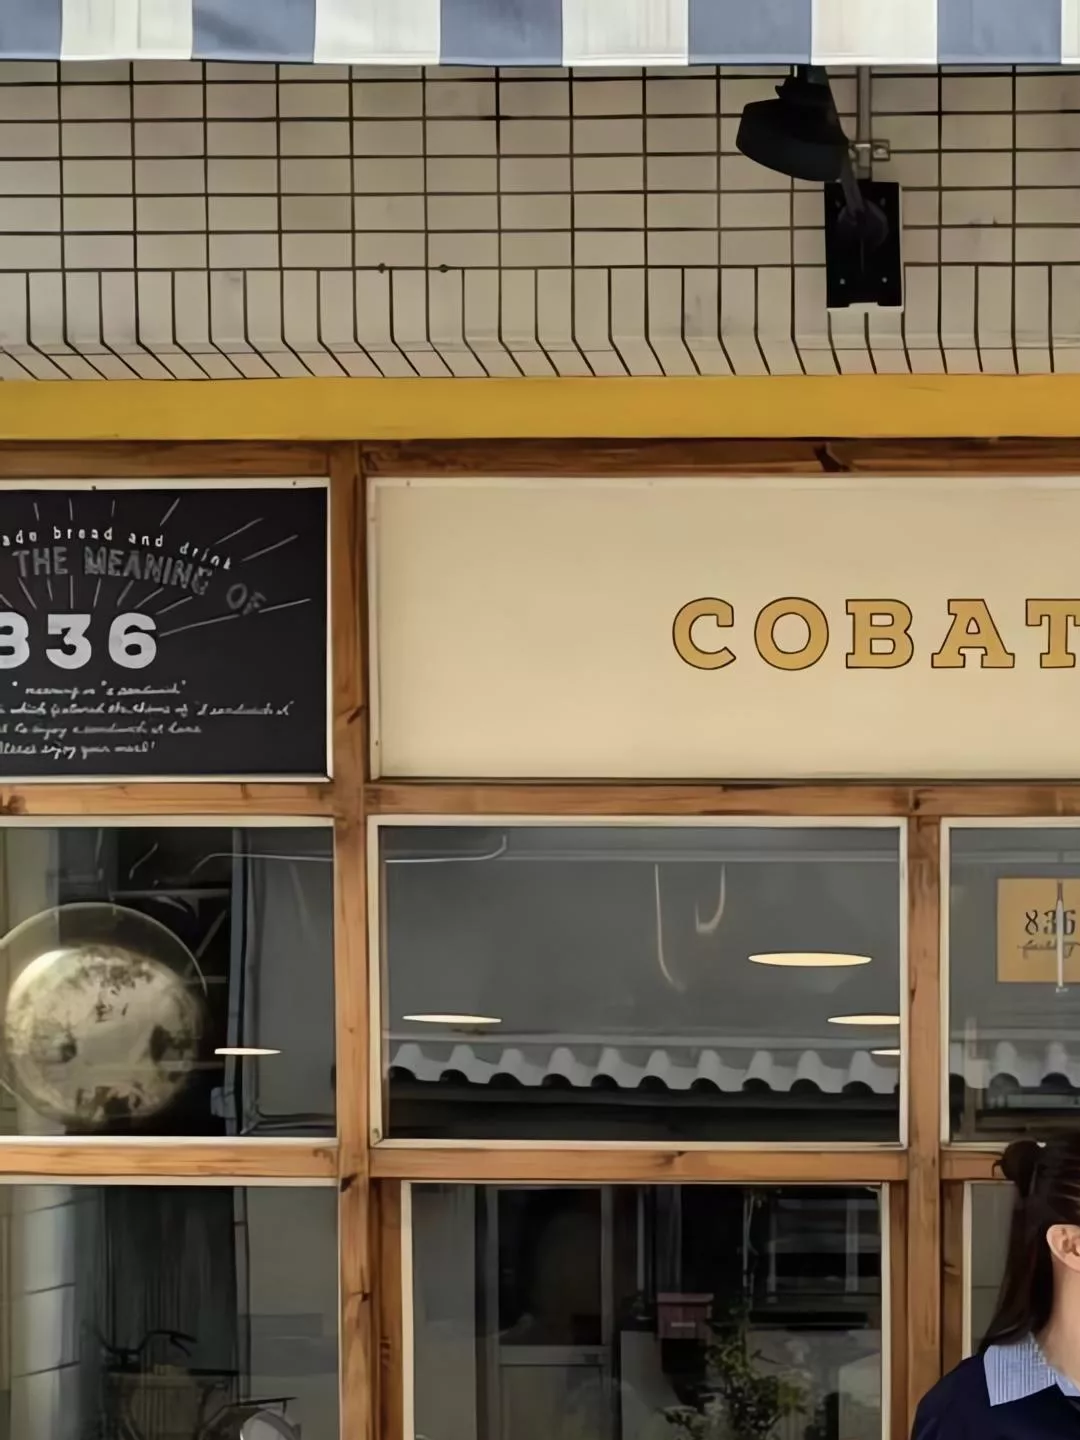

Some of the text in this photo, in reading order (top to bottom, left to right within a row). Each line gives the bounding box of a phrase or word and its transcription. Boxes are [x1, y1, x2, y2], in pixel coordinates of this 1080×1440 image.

[53, 525, 113, 541] bread
[128, 532, 164, 547] and
[12, 546, 69, 578] THE
[84, 545, 213, 596] MEANING
